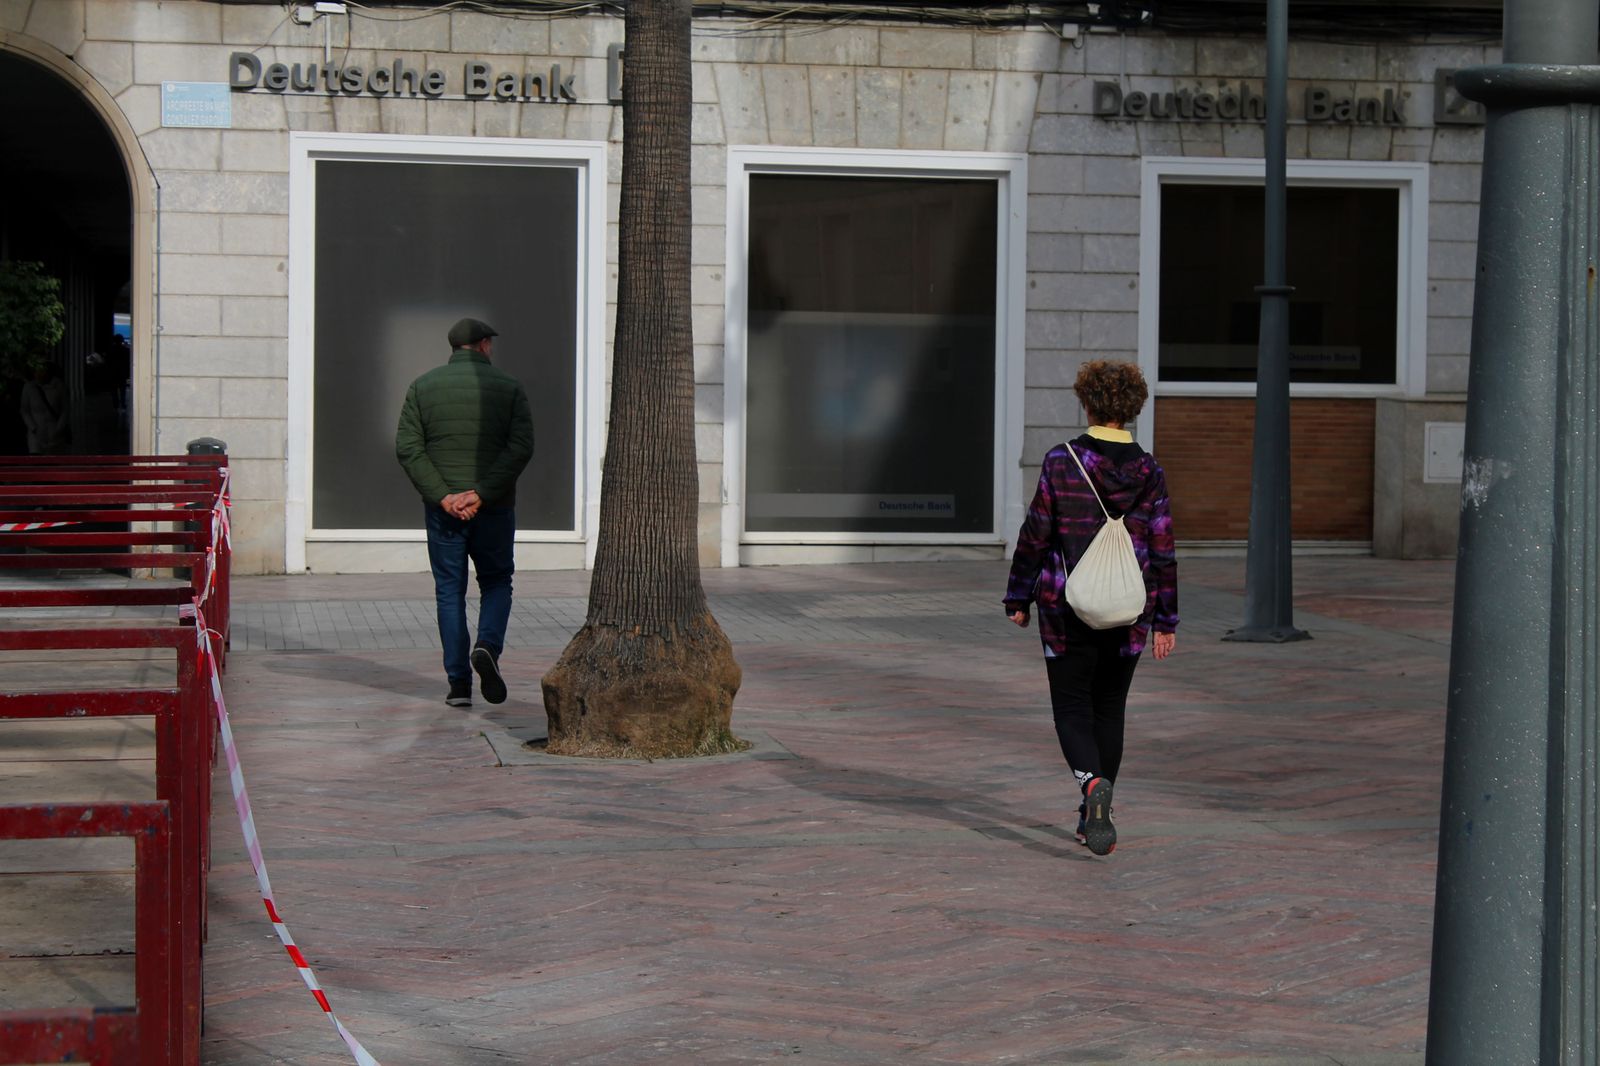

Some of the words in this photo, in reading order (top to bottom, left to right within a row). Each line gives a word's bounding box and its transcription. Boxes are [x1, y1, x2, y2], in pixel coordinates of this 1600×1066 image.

[229, 51, 446, 98] Deutsche
[464, 60, 577, 102] Bank
[1093, 79, 1267, 120] Deutsch
[1305, 87, 1407, 125] Bank
[879, 501, 925, 510] Deutsche
[927, 501, 952, 511] Bank
